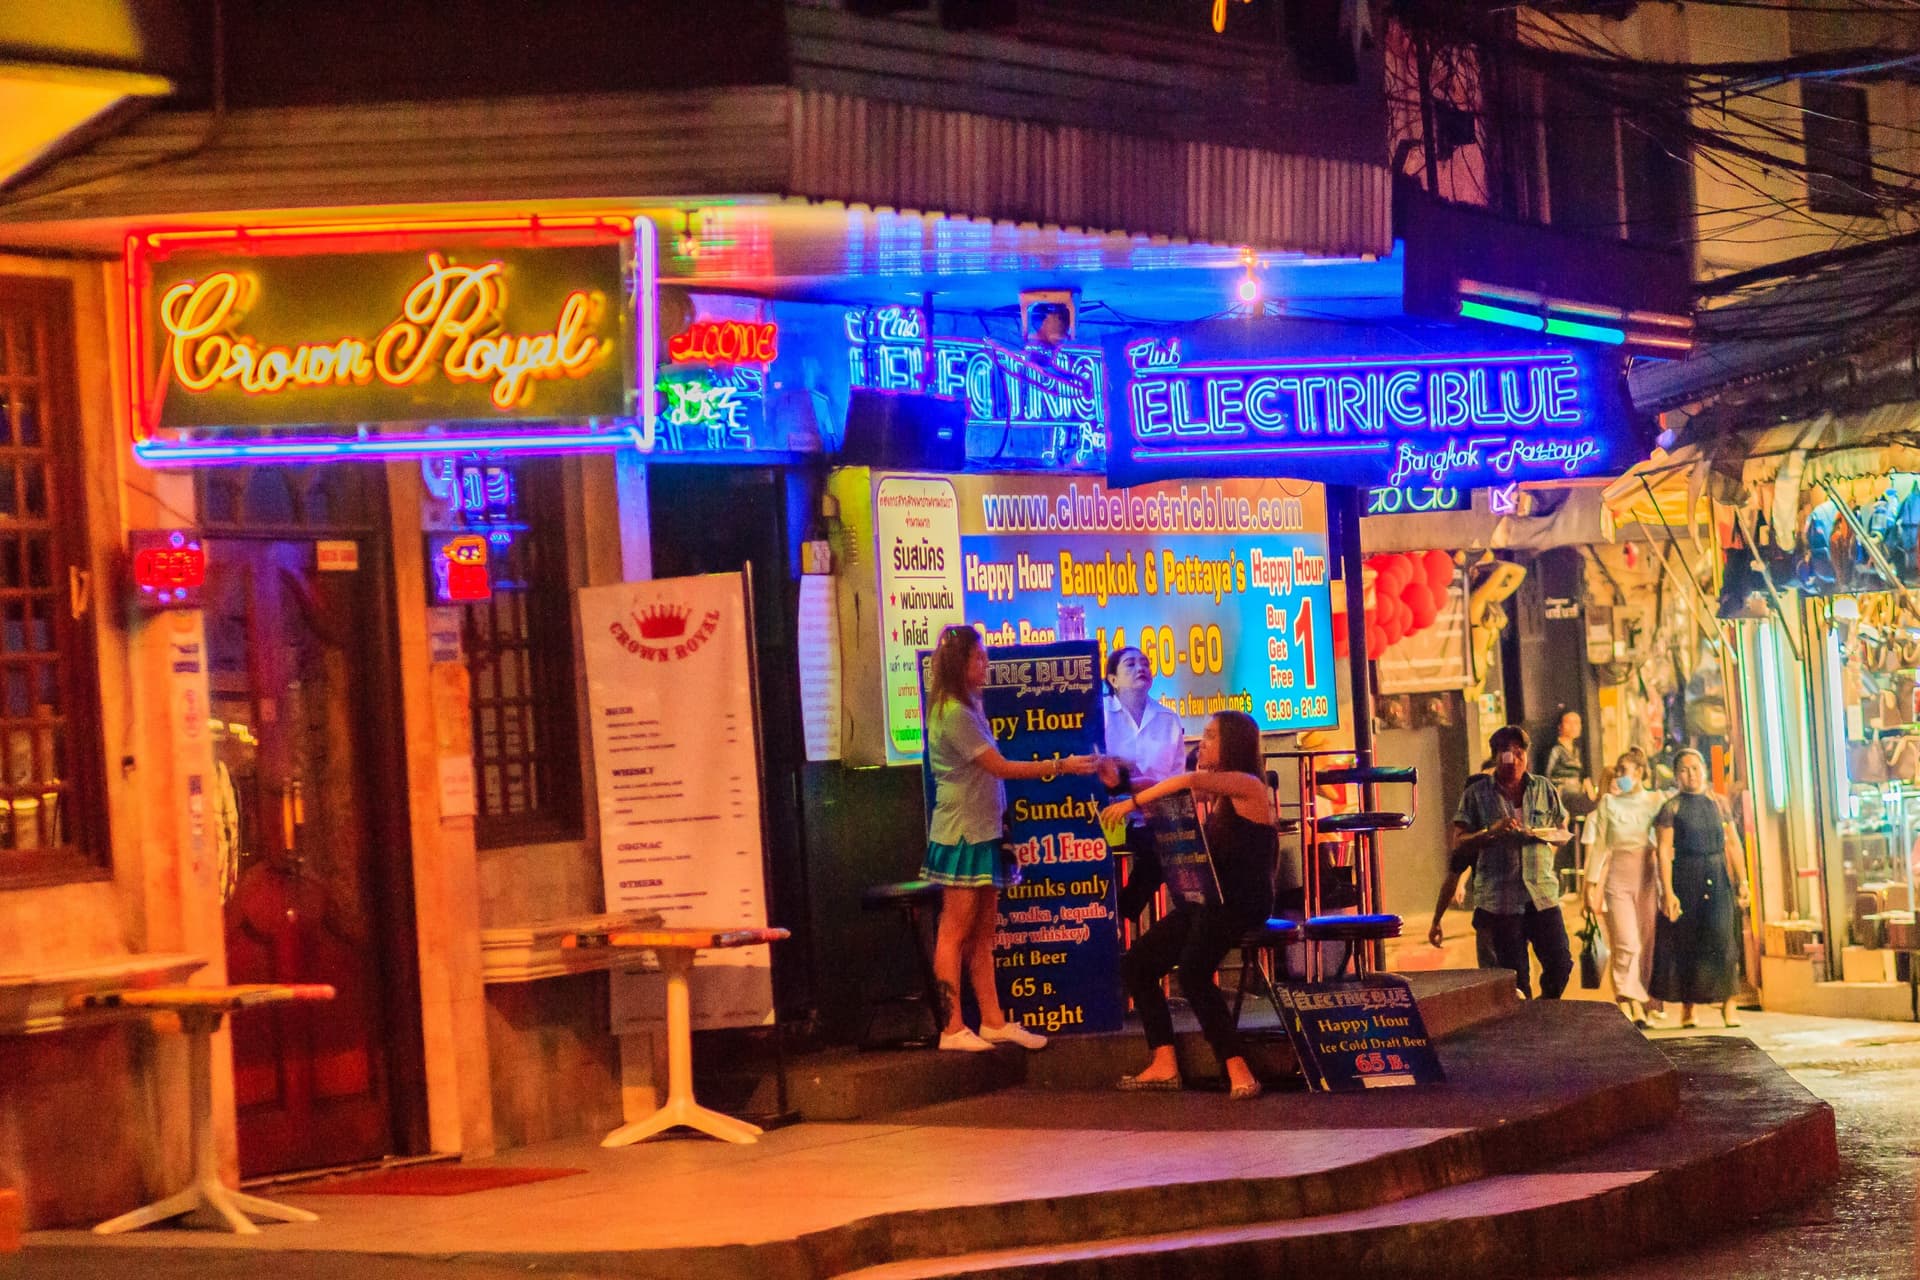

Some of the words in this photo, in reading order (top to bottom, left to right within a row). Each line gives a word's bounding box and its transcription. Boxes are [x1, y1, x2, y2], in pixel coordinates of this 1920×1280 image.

[159, 271, 372, 392] Crown
[374, 252, 599, 410] Royal
[1129, 341, 1180, 368] Club
[1132, 370, 1430, 437] ELECTRIC
[1431, 366, 1581, 428] BLUE
[983, 483, 1304, 533] www.clubelectricblue.com
[893, 536, 945, 571] รับสมัคร
[965, 553, 1015, 602] Happy
[1017, 551, 1055, 593] Hour
[1059, 549, 1139, 608] Bangkok
[1144, 549, 1157, 594] &
[1162, 547, 1246, 605] Pattaya's
[1249, 546, 1293, 595] Happy
[1293, 547, 1326, 587] Hour
[1266, 605, 1287, 634] Buy
[609, 620, 669, 663] CROWN
[675, 608, 721, 659] ROYAL
[1267, 636, 1289, 661] Get
[1293, 596, 1318, 690] 1
[1036, 657, 1094, 683] BLUE
[1270, 664, 1294, 690] Free
[1026, 708, 1085, 732] Hour
[1265, 698, 1293, 721] 19.30
[1300, 695, 1329, 719] 21.30
[1015, 796, 1099, 824] Sunday
[1016, 836, 1041, 867] et
[1058, 832, 1107, 862] Free
[1070, 875, 1110, 900] only
[996, 952, 1025, 968] raft
[1030, 950, 1068, 966] Beer
[1011, 977, 1036, 998] 65
[1043, 982, 1057, 996] B.
[1023, 1005, 1084, 1032] night
[1317, 1018, 1369, 1035] Happy
[1372, 1015, 1409, 1029] Hour
[1320, 1043, 1337, 1054] Ice
[1339, 1038, 1368, 1053] Cold
[1370, 1037, 1400, 1050] Draft
[1402, 1036, 1428, 1048] Beer
[1354, 1052, 1386, 1073] 65
[1387, 1054, 1411, 1071] B.
